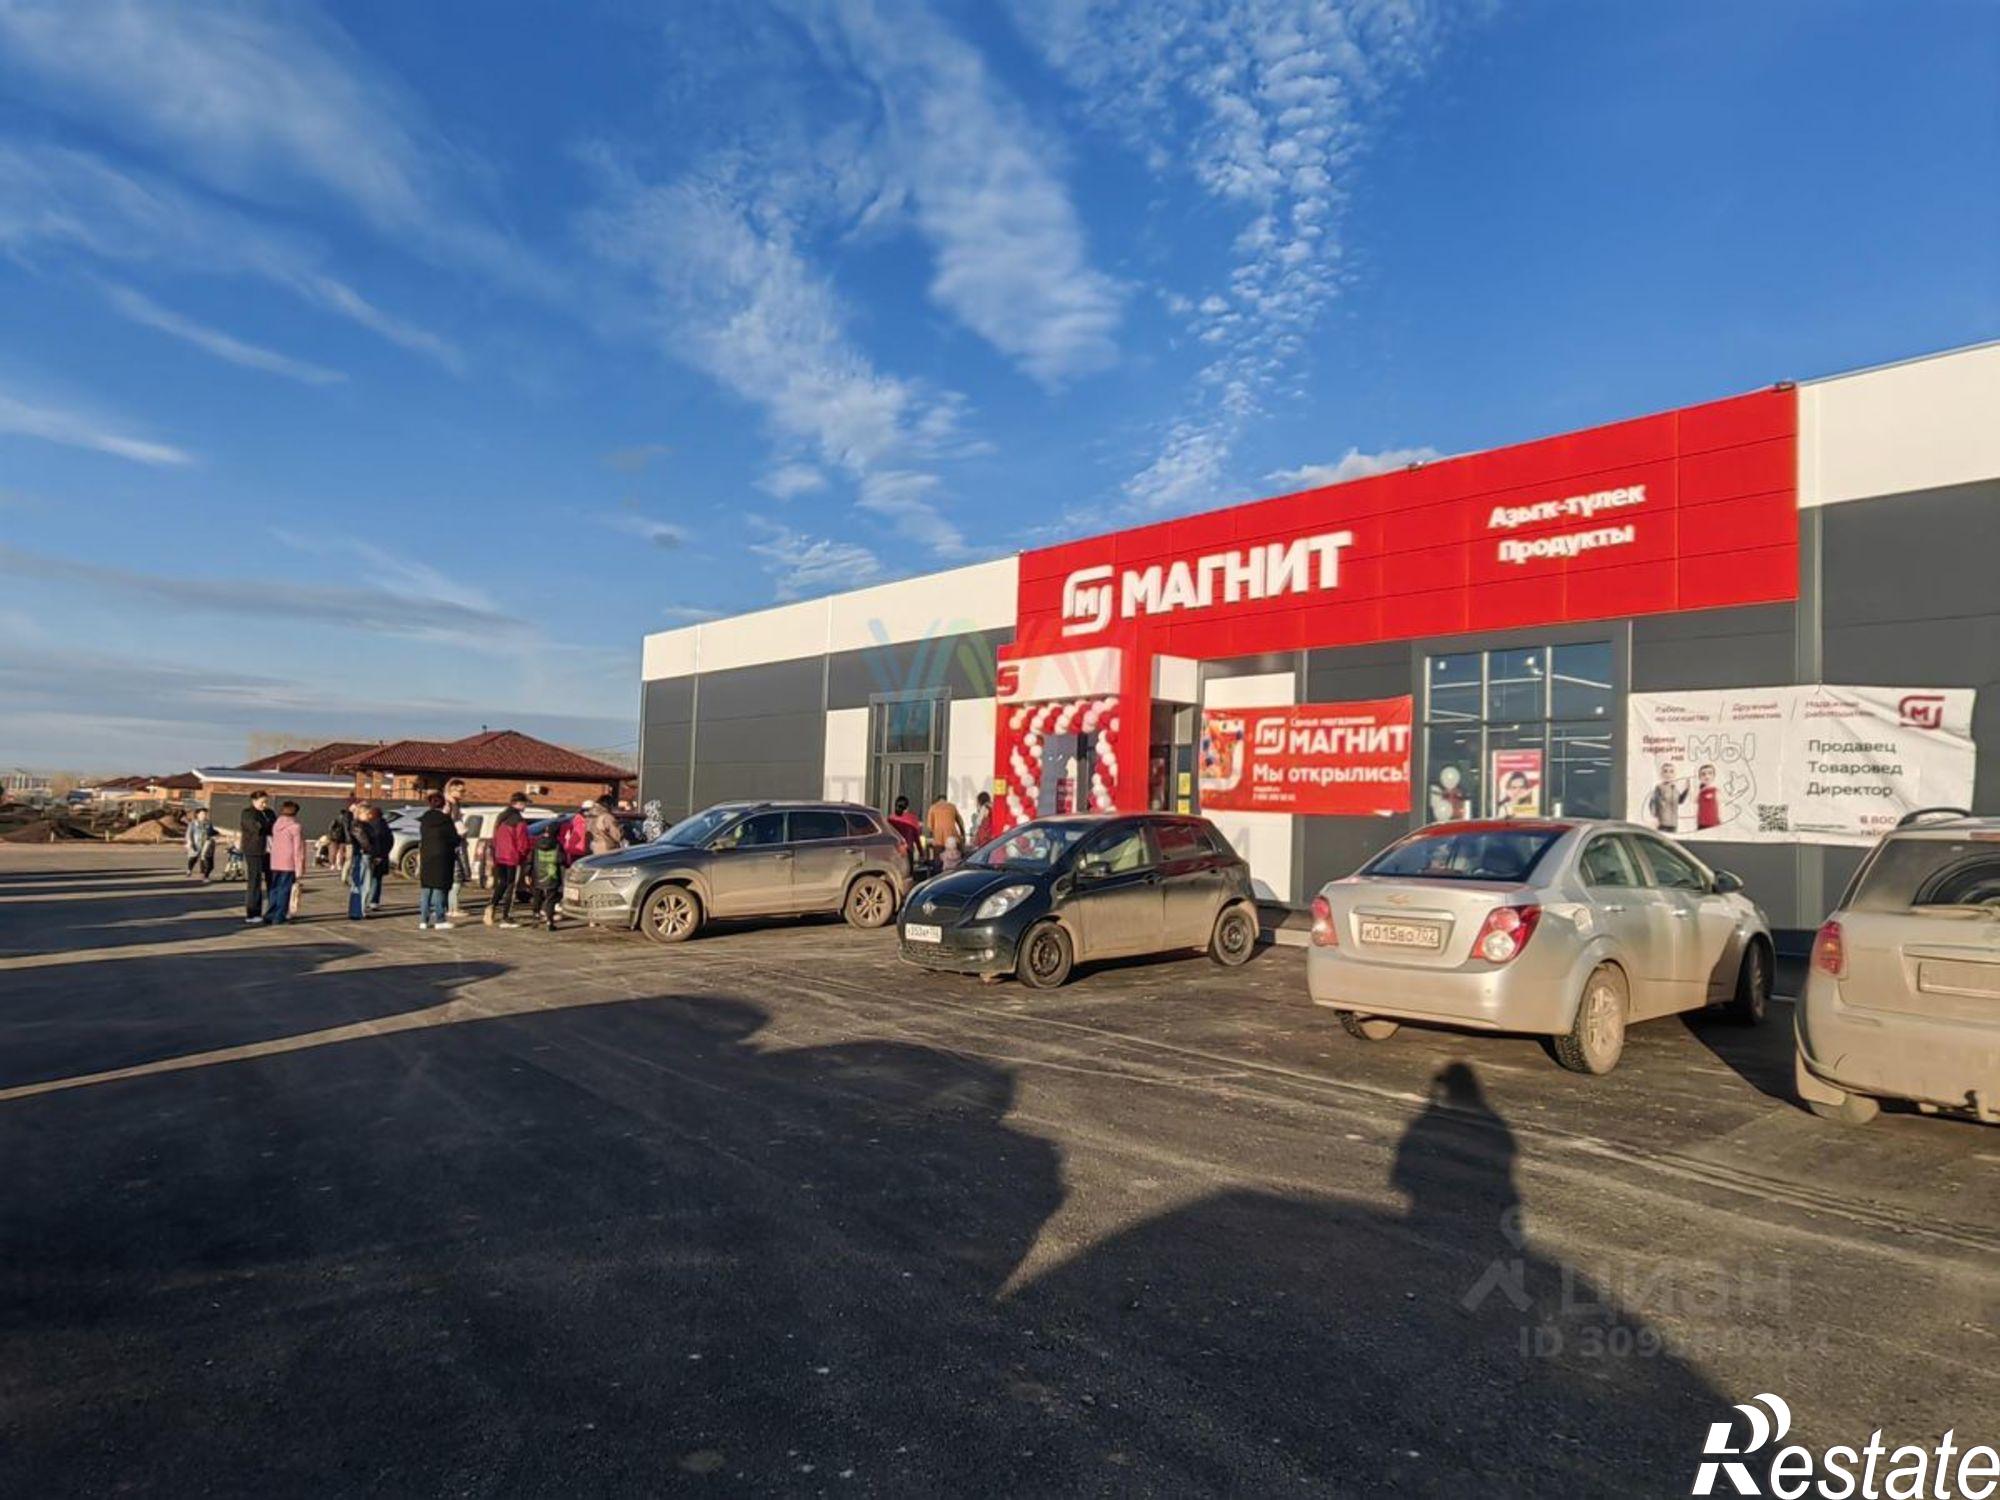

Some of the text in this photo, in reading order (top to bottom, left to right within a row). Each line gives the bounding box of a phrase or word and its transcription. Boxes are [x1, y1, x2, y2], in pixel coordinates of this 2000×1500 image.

[1498, 525, 1635, 565] Продукты
[1121, 530, 1353, 618] МАГНИТ
[1289, 724, 1410, 755] МАГНИТ
[1808, 739, 1897, 754] Продавец
[1253, 760, 1410, 786] Мы открылись!
[1807, 760, 1903, 775] Товаровед
[1806, 781, 1893, 797] Директор
